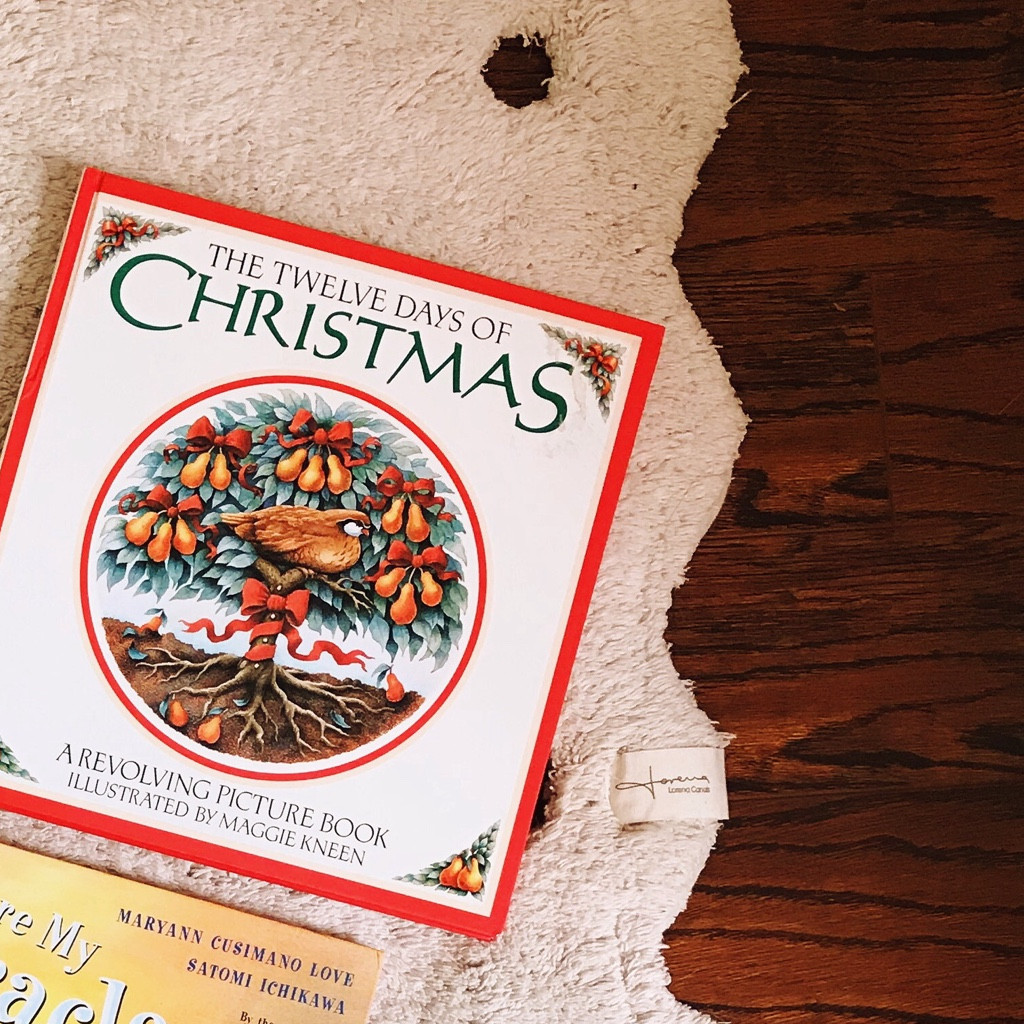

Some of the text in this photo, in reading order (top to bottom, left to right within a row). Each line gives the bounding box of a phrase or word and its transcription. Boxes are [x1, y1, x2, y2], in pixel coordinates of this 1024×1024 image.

[208, 243, 513, 344] THE TWELVE DAYS OF
[109, 252, 575, 434] CHRISTMAS
[56, 742, 391, 850] A REVOLVING PICTURE BOOK
[67, 772, 367, 867] ILLUSTRATED BY MAGGIE KNEEN
[36, 912, 103, 976] My
[117, 908, 356, 988] MARYANN CUSIMANO LOVE
[187, 958, 346, 1016] SATOMI ICHIKAWA
